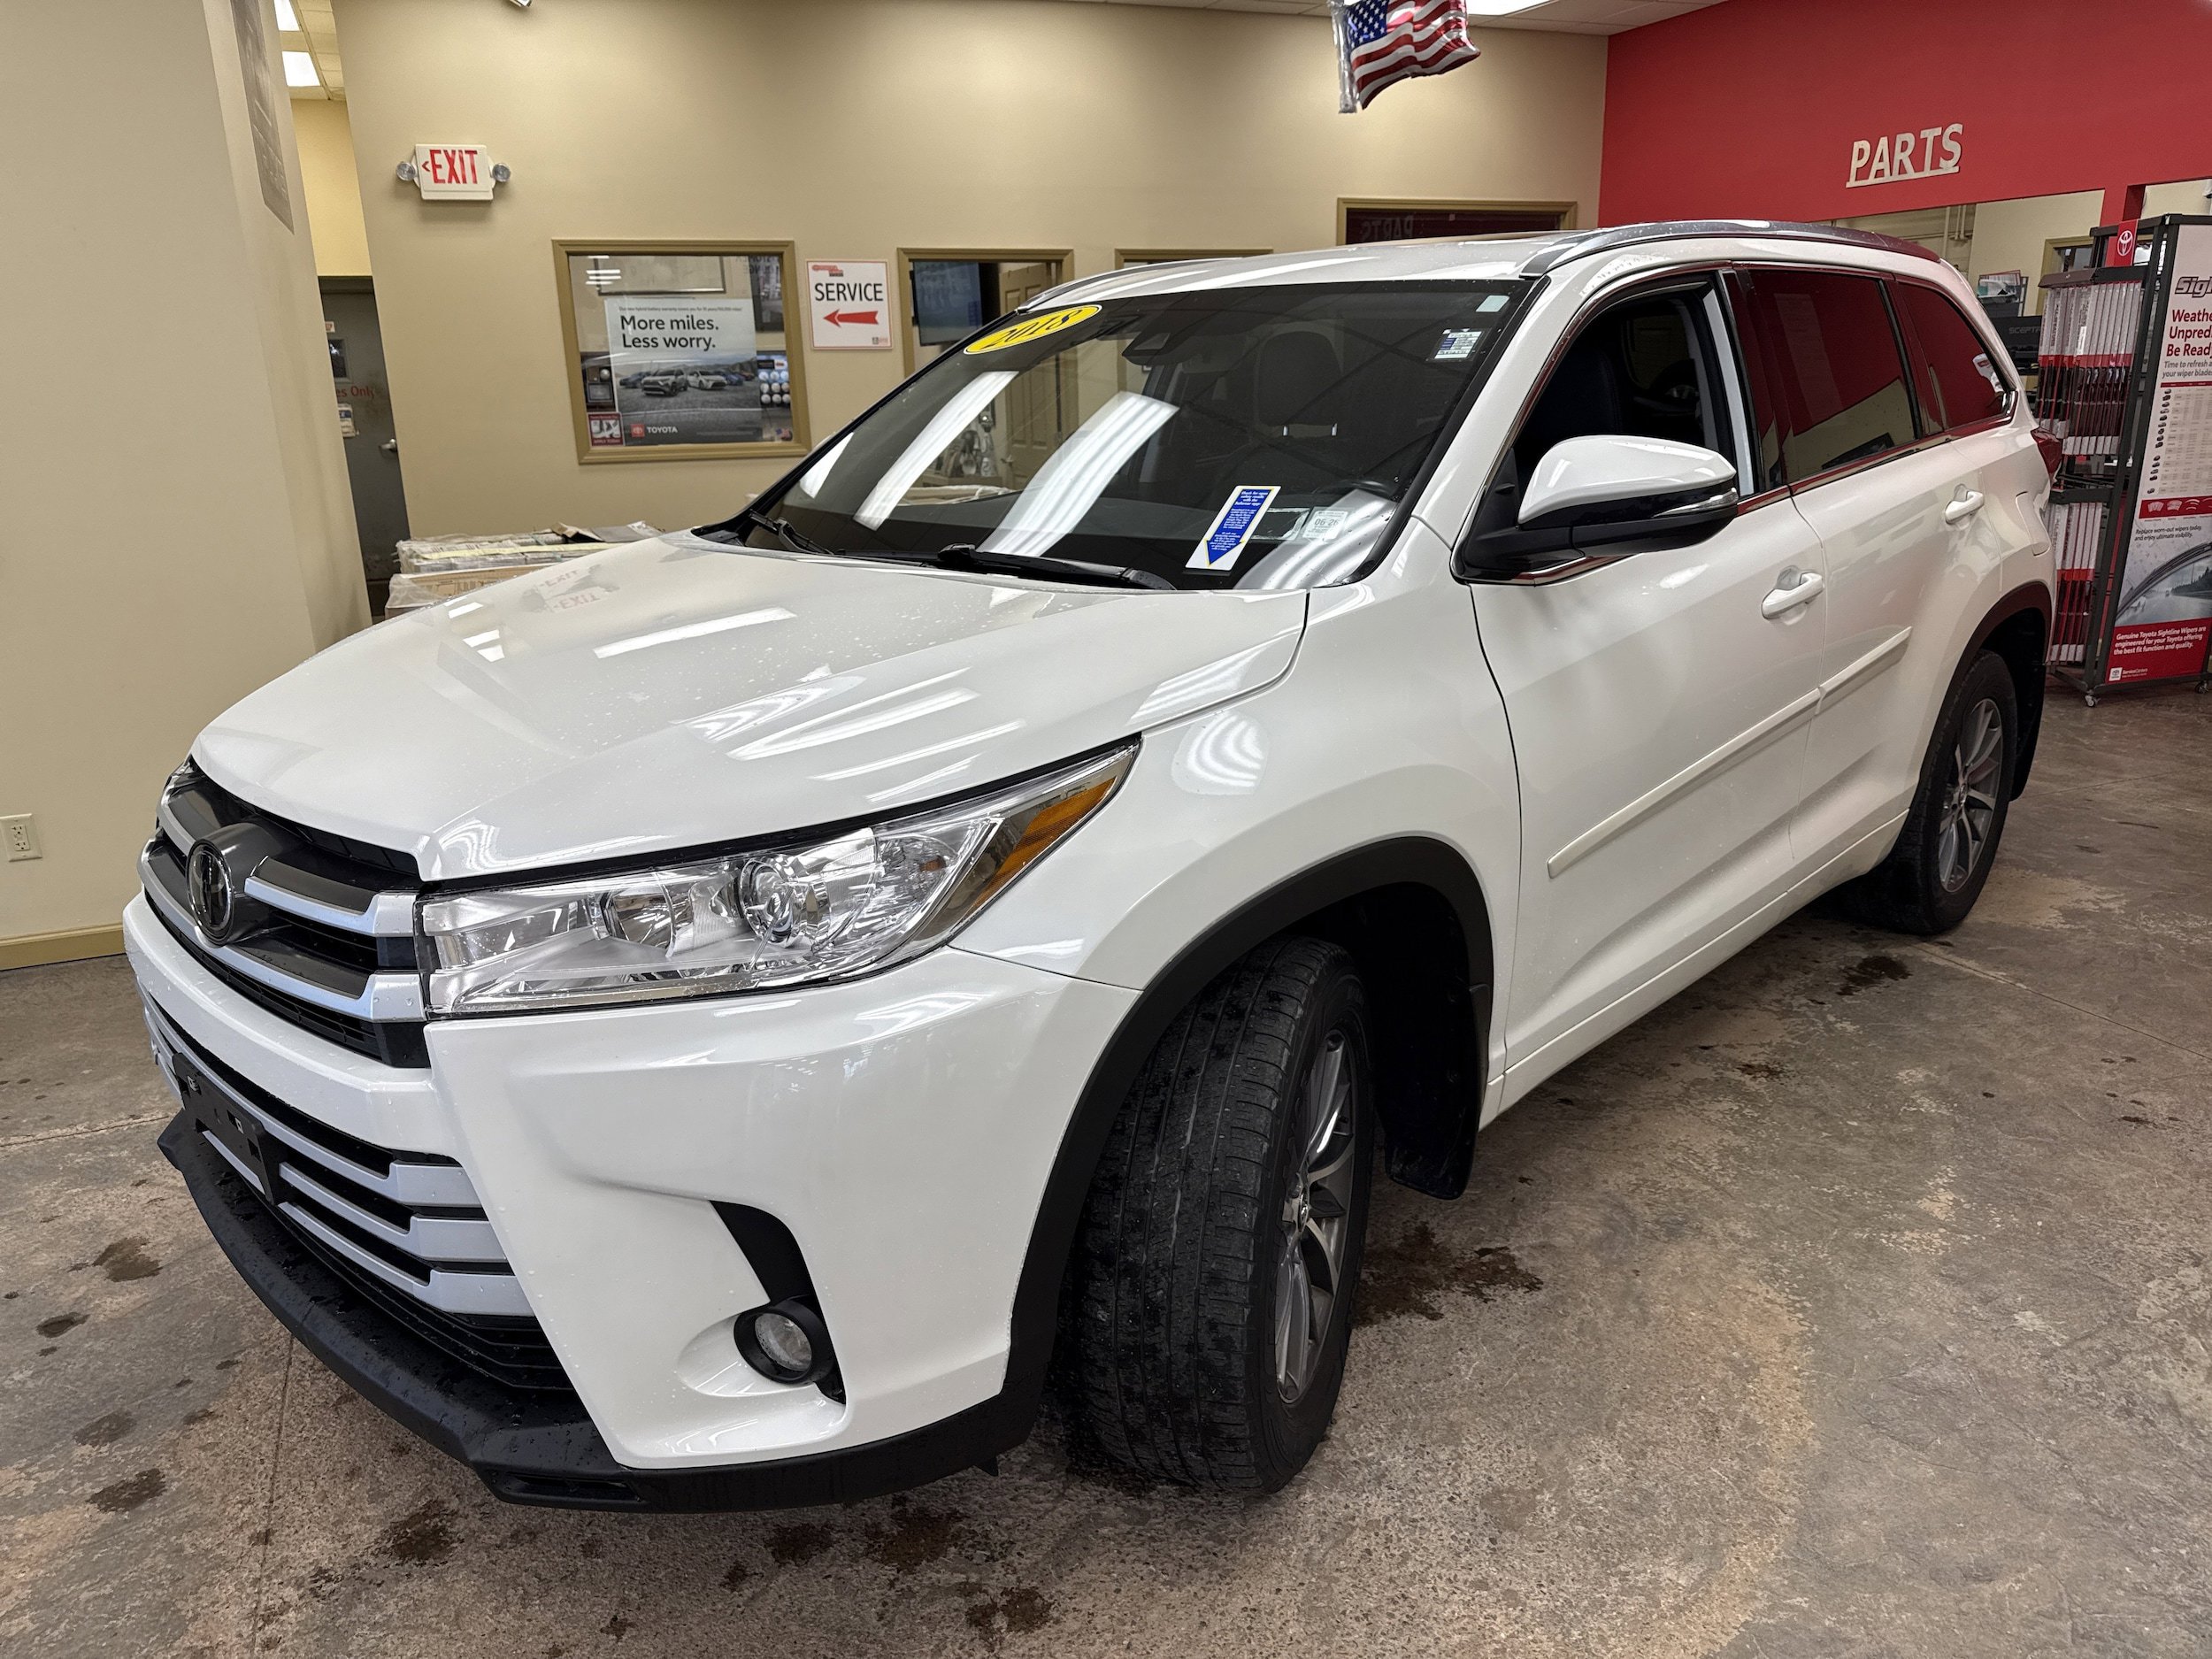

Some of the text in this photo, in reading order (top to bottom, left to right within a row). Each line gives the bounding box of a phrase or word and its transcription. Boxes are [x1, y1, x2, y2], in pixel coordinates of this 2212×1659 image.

[1848, 123, 1963, 183] PARTS
[429, 150, 478, 184] EXIT
[815, 283, 883, 302] SERVICE
[620, 314, 718, 330] More miles.
[979, 310, 1083, 350] 2018
[2169, 326, 2212, 342] Unpred
[622, 334, 716, 351] Less worry.
[2166, 343, 2180, 357] Be
[2187, 359, 2208, 368] refresh
[2115, 640, 2145, 649] engineered
